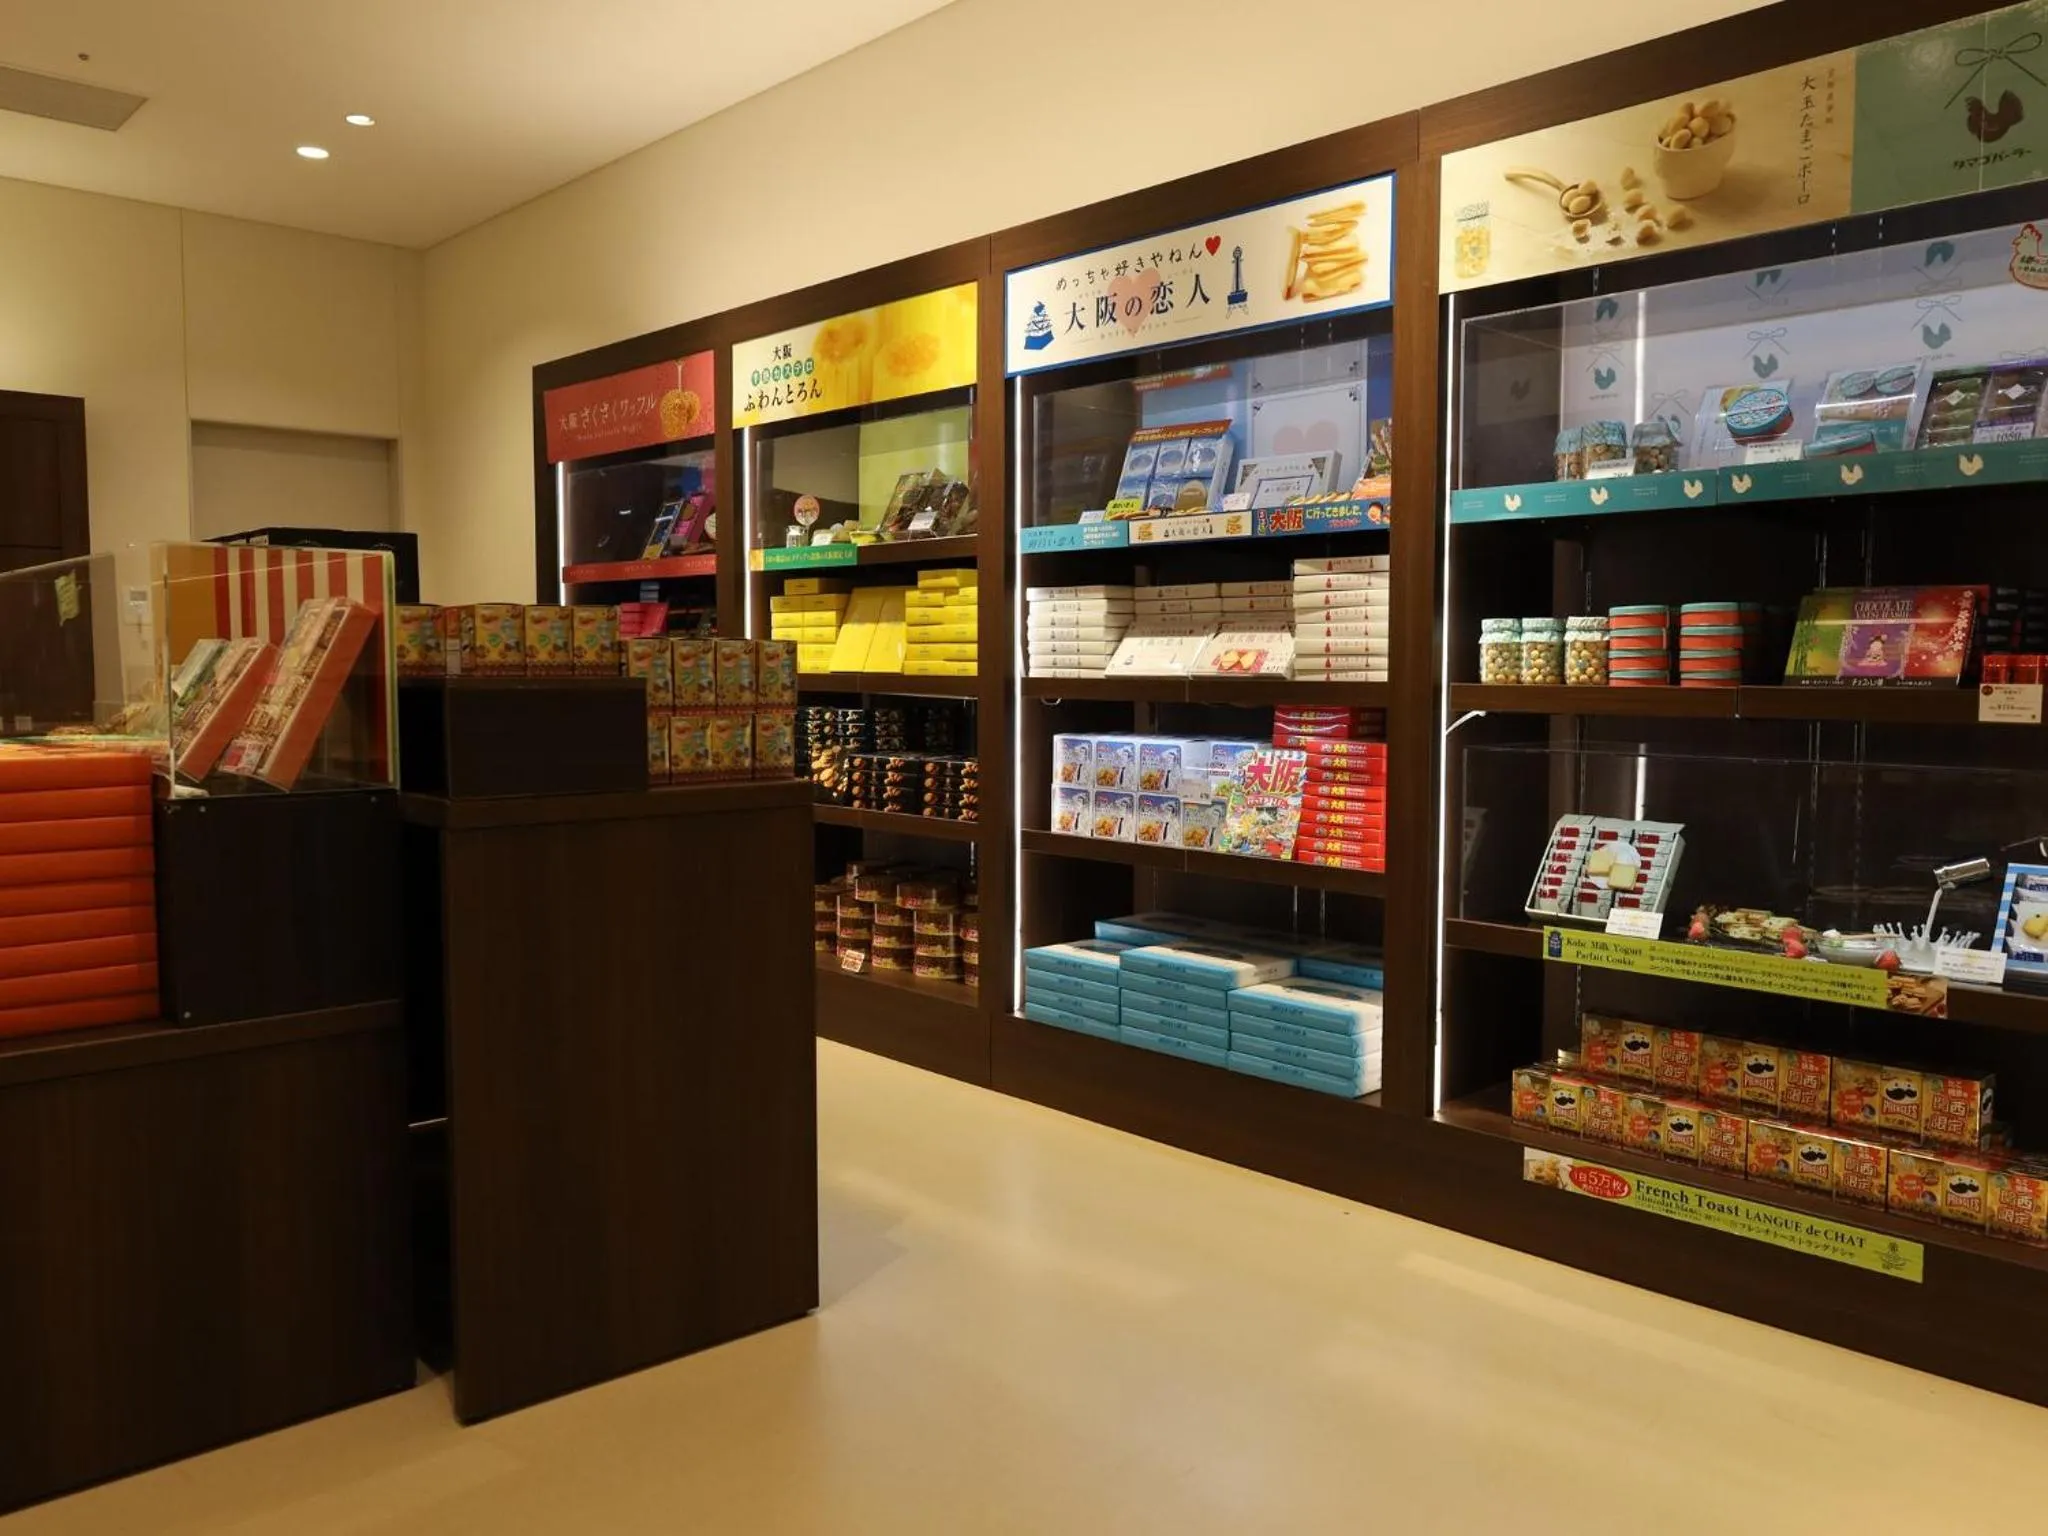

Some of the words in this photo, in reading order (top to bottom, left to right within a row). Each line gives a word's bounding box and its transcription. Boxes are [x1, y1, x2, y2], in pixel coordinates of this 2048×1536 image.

[1055, 242, 1203, 291] めっちゃ好きやねん
[1063, 273, 1211, 336] 大阪の恋人
[772, 343, 793, 361] 大阪
[744, 378, 823, 412] ふわんとろん
[1269, 508, 1304, 533] 大阪
[1244, 757, 1304, 793] 大阪
[1576, 951, 1602, 961] Parfait
[1606, 955, 1634, 966] Cookie
[1591, 942, 1608, 951] Milk
[1614, 944, 1642, 956] Yogurt
[1744, 1073, 1776, 1092] PRINGLES
[1883, 1099, 1919, 1120] PRINGLES
[1636, 1180, 1689, 1205] French
[1694, 1194, 1740, 1217] Toast
[1745, 1208, 1801, 1232] LANGUE
[1805, 1224, 1820, 1237] de
[1823, 1228, 1866, 1248] CHAT
[1947, 1194, 1980, 1213] PRINGLES
